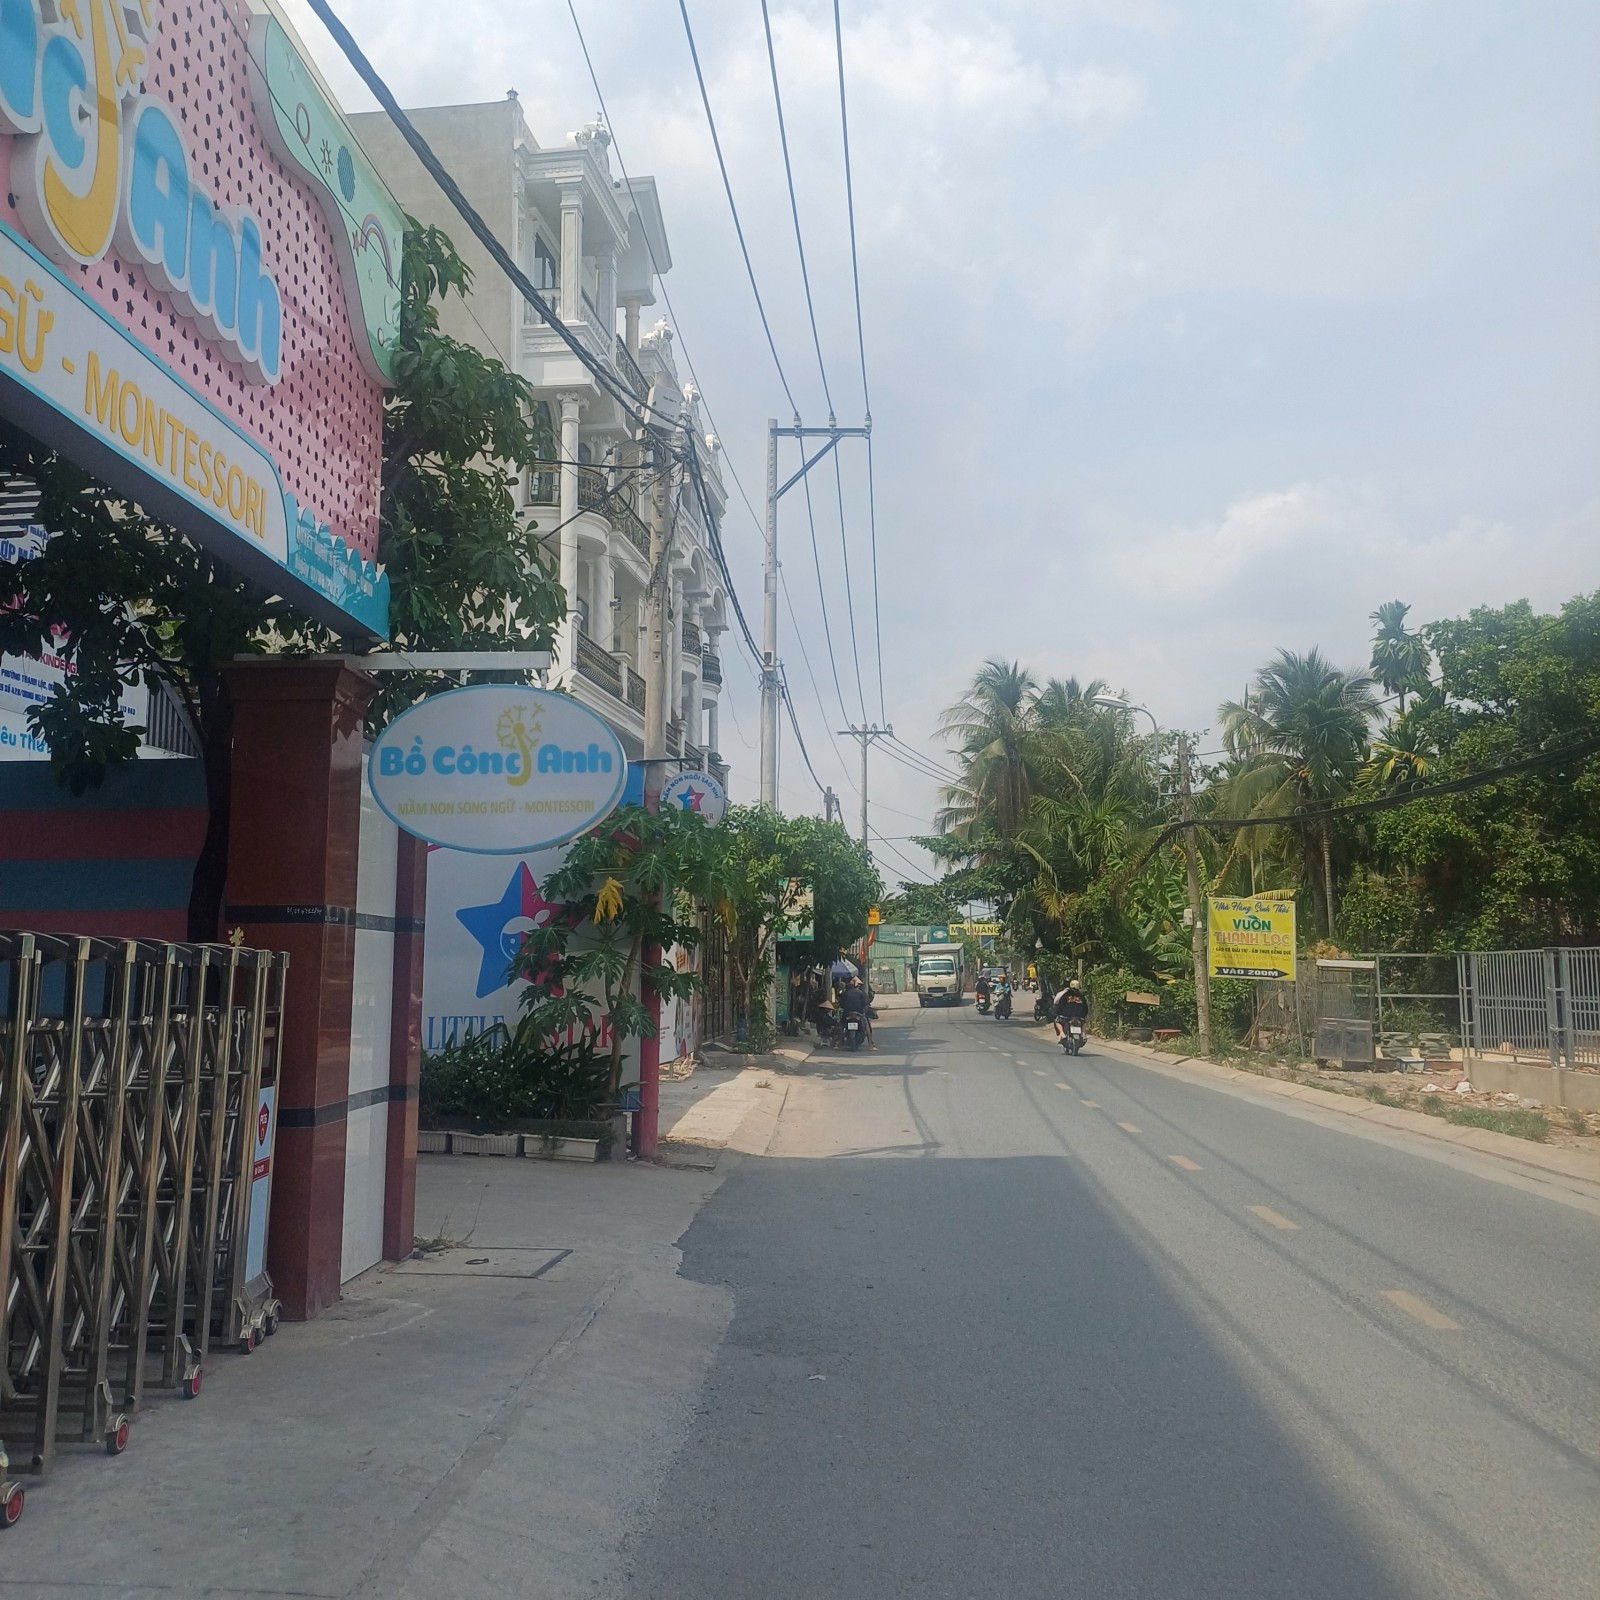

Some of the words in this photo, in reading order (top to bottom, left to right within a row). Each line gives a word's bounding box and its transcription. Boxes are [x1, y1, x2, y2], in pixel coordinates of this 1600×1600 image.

[131, 106, 282, 376] Anh
[85, 352, 268, 540] MONTESSORI
[380, 736, 427, 777] Bồ
[433, 741, 533, 787] Công
[537, 742, 612, 775] Anh
[670, 776, 684, 788] NON
[684, 773, 701, 781] NGÔI
[701, 777, 713, 788] SAO
[397, 798, 429, 816] MẦM
[430, 802, 456, 816] NON
[458, 802, 488, 815] SONG
[490, 799, 517, 815] NGỮ
[525, 800, 596, 815] MONTESSORI
[1231, 901, 1252, 914] Hàng
[1254, 901, 1270, 913] Sinh
[1222, 967, 1244, 975] VÀO
